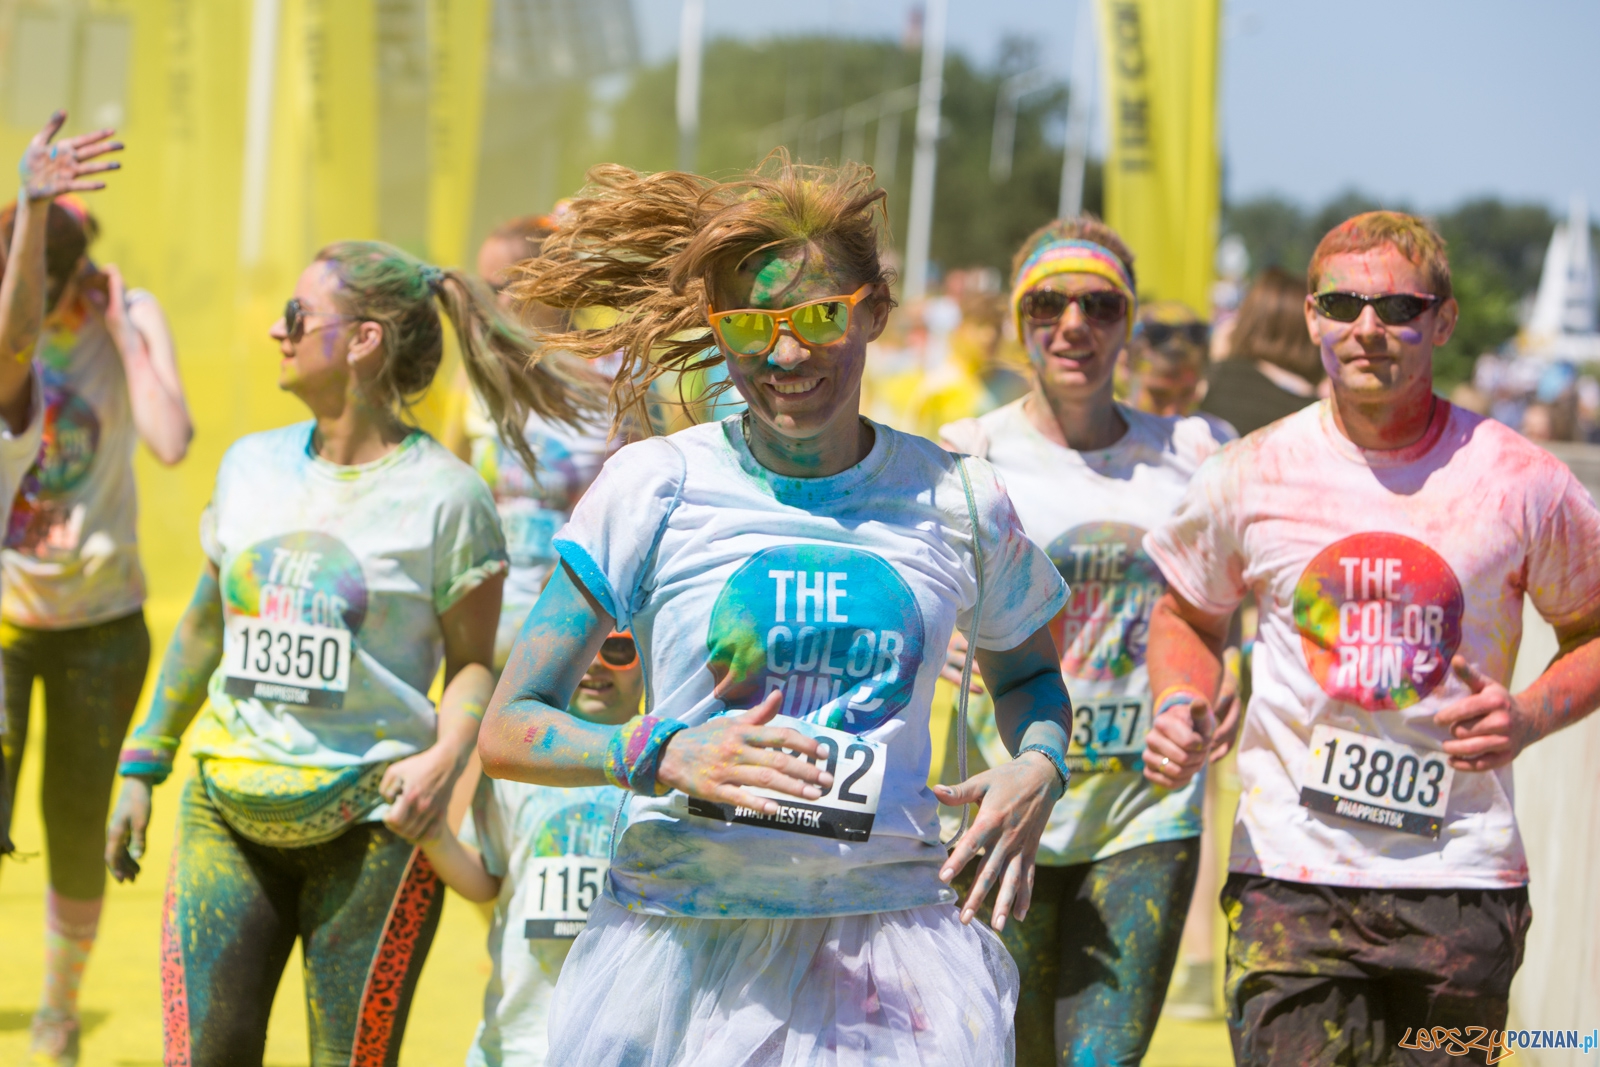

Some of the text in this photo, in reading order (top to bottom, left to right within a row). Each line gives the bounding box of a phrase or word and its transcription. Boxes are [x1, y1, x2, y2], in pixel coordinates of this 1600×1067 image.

[268, 547, 323, 589] THE
[1069, 543, 1126, 580] THE
[1339, 557, 1402, 600] THE
[768, 569, 849, 623] THE
[1339, 601, 1444, 646] COLOR
[240, 627, 340, 682] 13350
[766, 625, 904, 684] COLOR
[1336, 644, 1404, 690] RUN
[1321, 738, 1446, 808] 13803
[734, 805, 823, 829] #HIEST5K
[538, 866, 608, 912] 115
